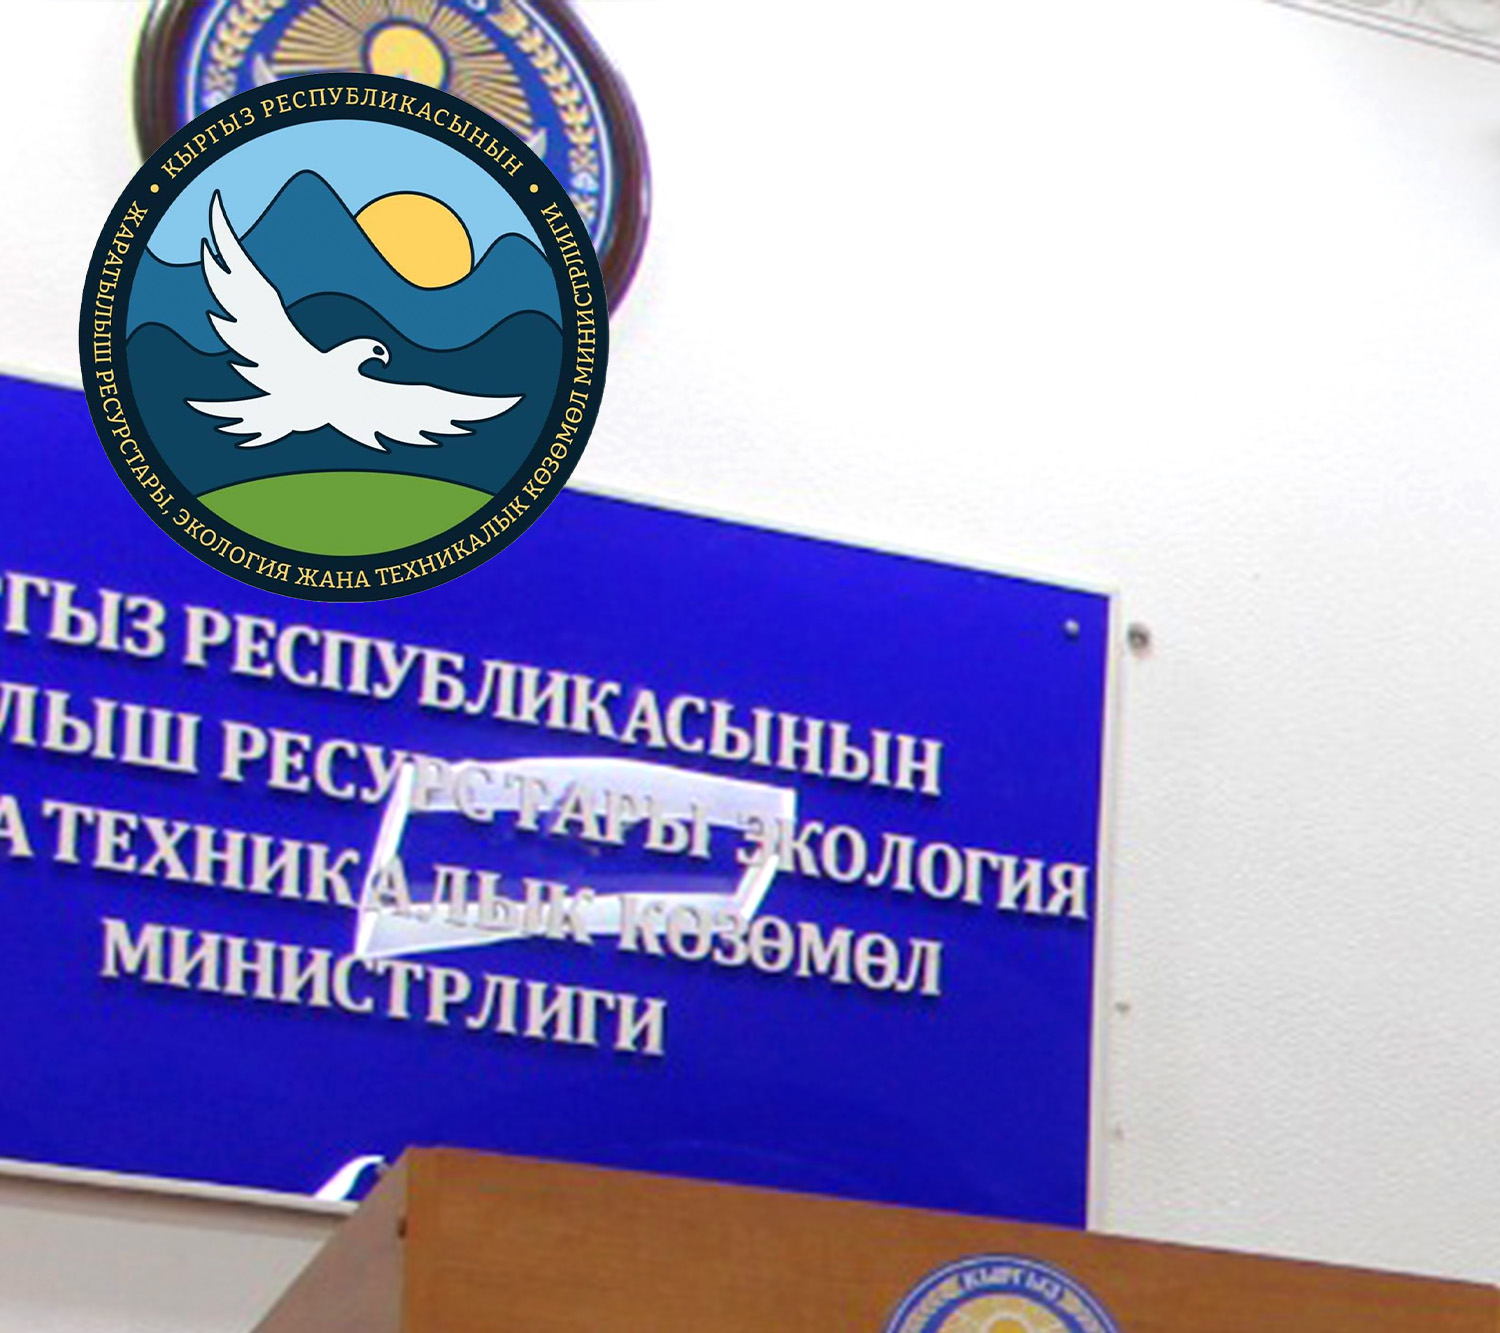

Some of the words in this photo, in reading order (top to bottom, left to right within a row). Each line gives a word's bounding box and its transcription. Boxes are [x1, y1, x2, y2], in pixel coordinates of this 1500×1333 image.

[0, 572, 166, 658] ГЫЗ
[183, 605, 943, 797] РЕСПУБЛИКАСЫНЫН
[219, 720, 711, 860] РЕСУРСТАРЫ
[734, 806, 1090, 918] ЭКОЛОГИЯ
[100, 918, 667, 1057] МИНИСТРЛИГИ
[618, 893, 943, 996] КӨЗӨМӨЛ
